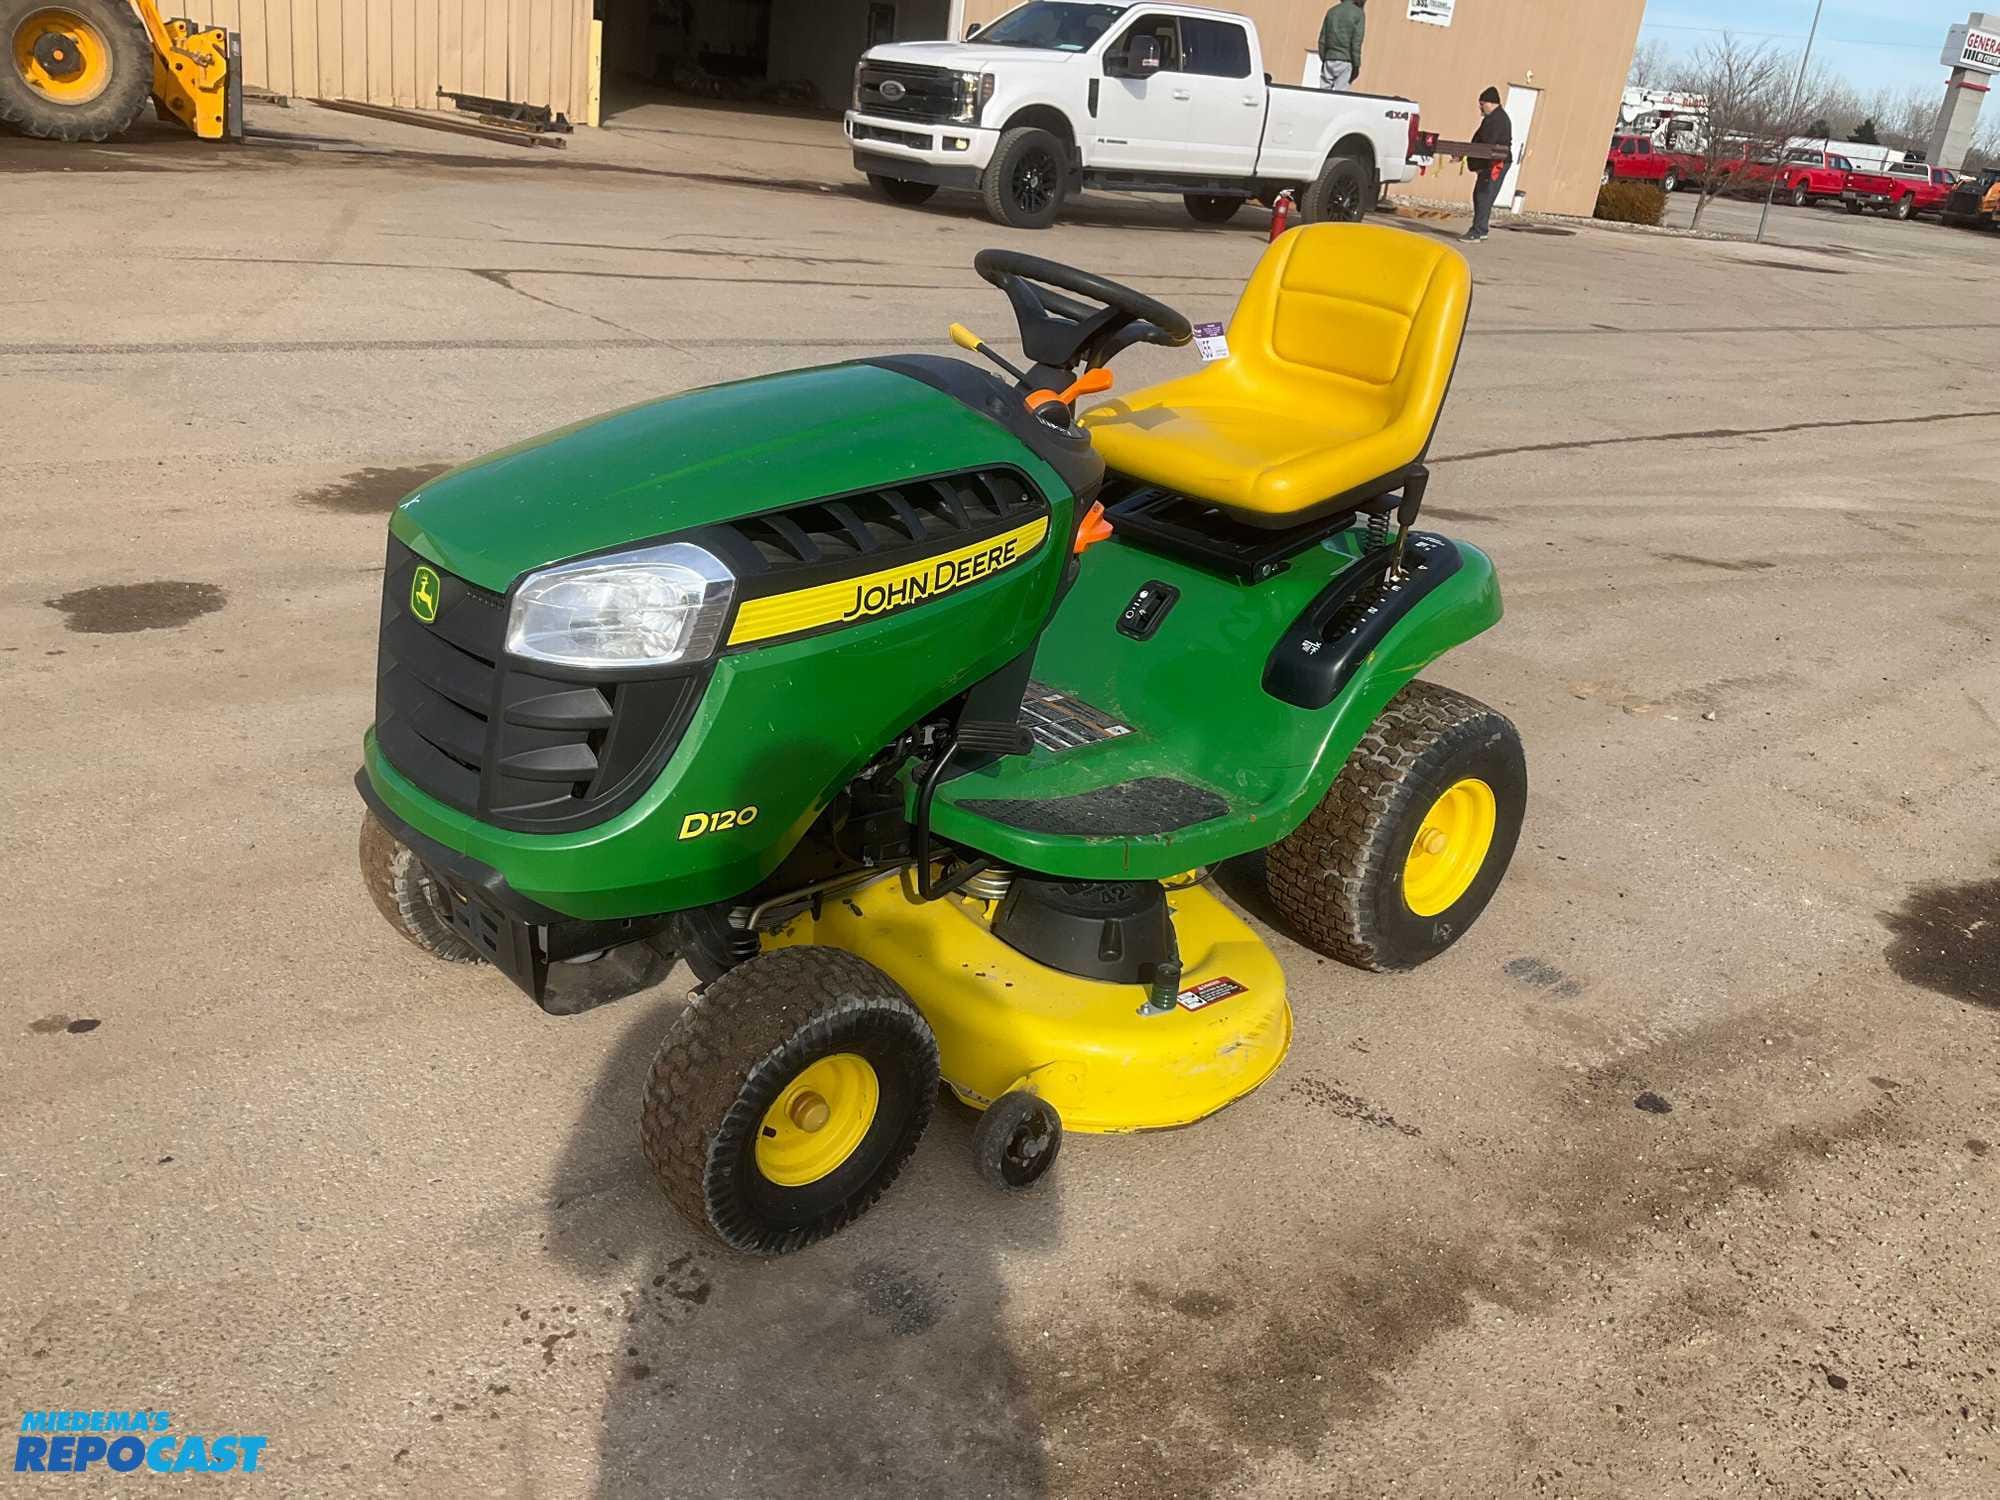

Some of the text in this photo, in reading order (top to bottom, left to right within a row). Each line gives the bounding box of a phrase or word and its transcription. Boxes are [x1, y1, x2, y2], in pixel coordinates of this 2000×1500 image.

[843, 538, 1018, 618] JOHN DEERE
[678, 804, 758, 840] D120
